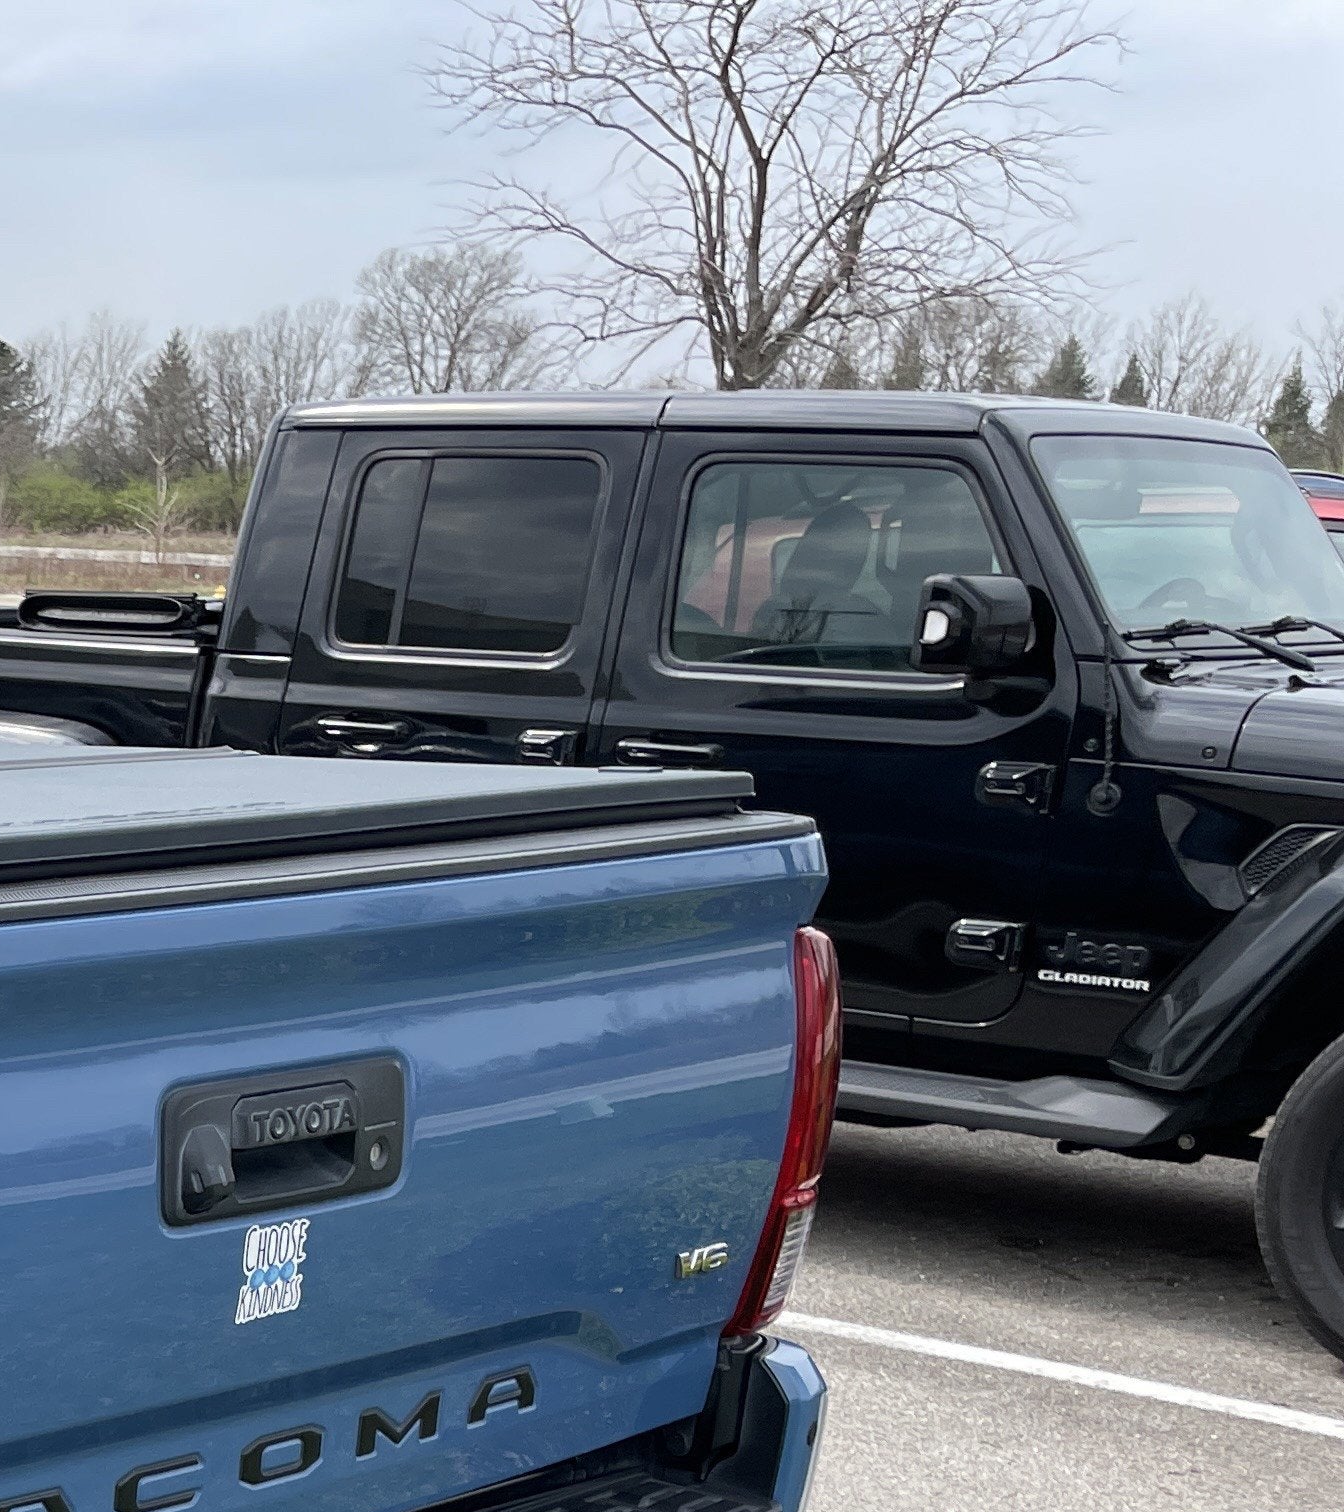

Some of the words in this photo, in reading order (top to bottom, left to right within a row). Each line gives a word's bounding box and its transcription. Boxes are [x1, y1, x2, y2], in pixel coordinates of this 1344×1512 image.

[1046, 930, 1150, 977] Jeep
[1037, 968, 1151, 993] GLADIATOR
[249, 1097, 357, 1143] TOYOTA
[244, 1219, 310, 1274] CHOOSE
[675, 1242, 729, 1278] V6
[236, 1276, 302, 1323] KINDNESS
